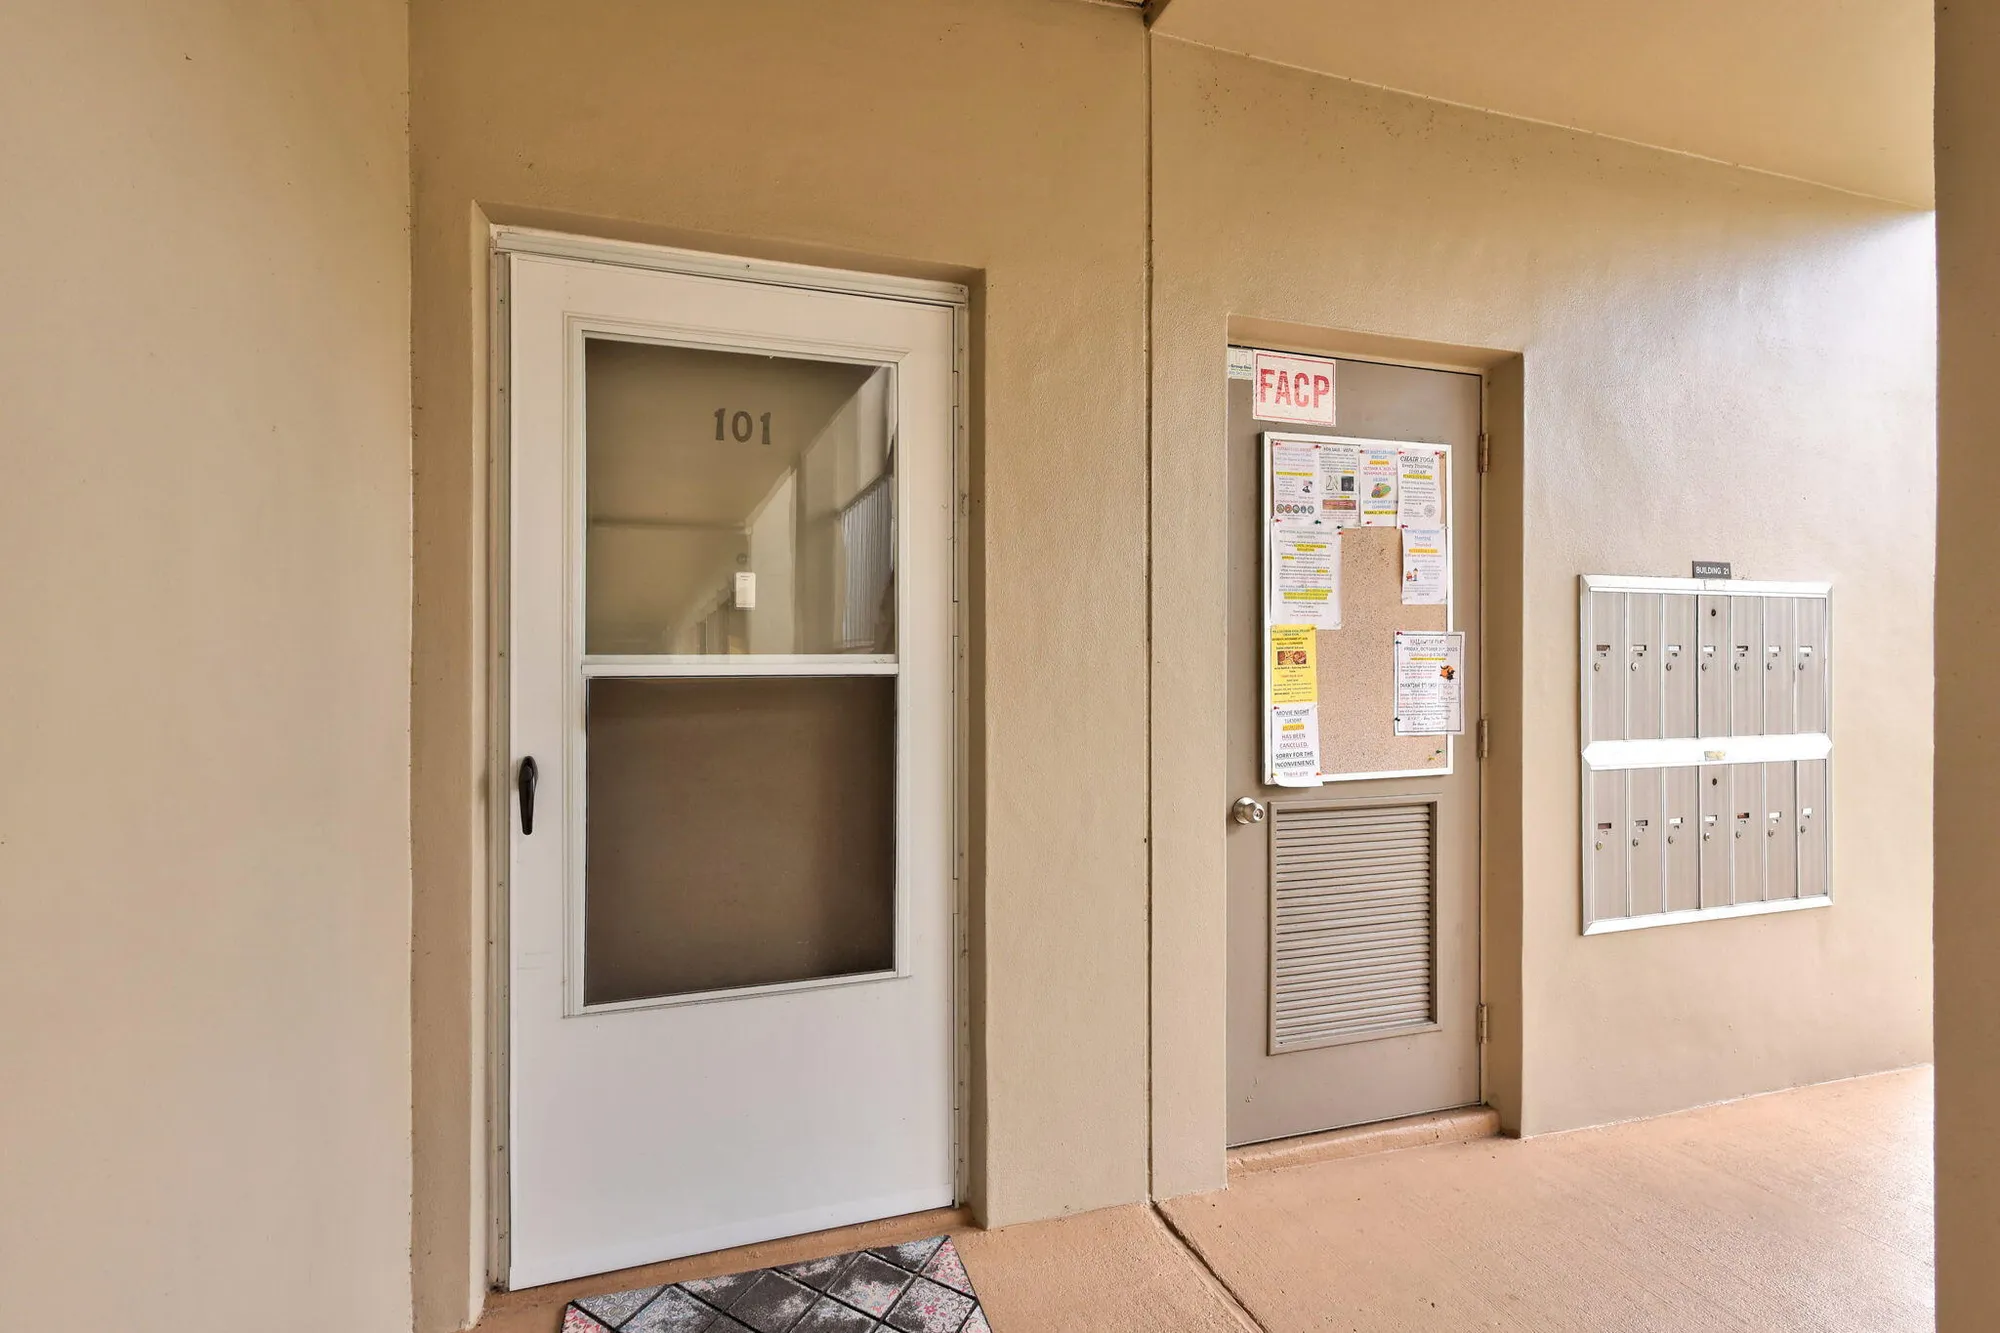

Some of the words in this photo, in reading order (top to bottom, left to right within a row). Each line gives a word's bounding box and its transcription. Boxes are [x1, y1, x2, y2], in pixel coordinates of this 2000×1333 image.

[1260, 368, 1330, 408] FACP
[714, 408, 772, 445] 101
[1696, 566, 1721, 574] BUILDING
